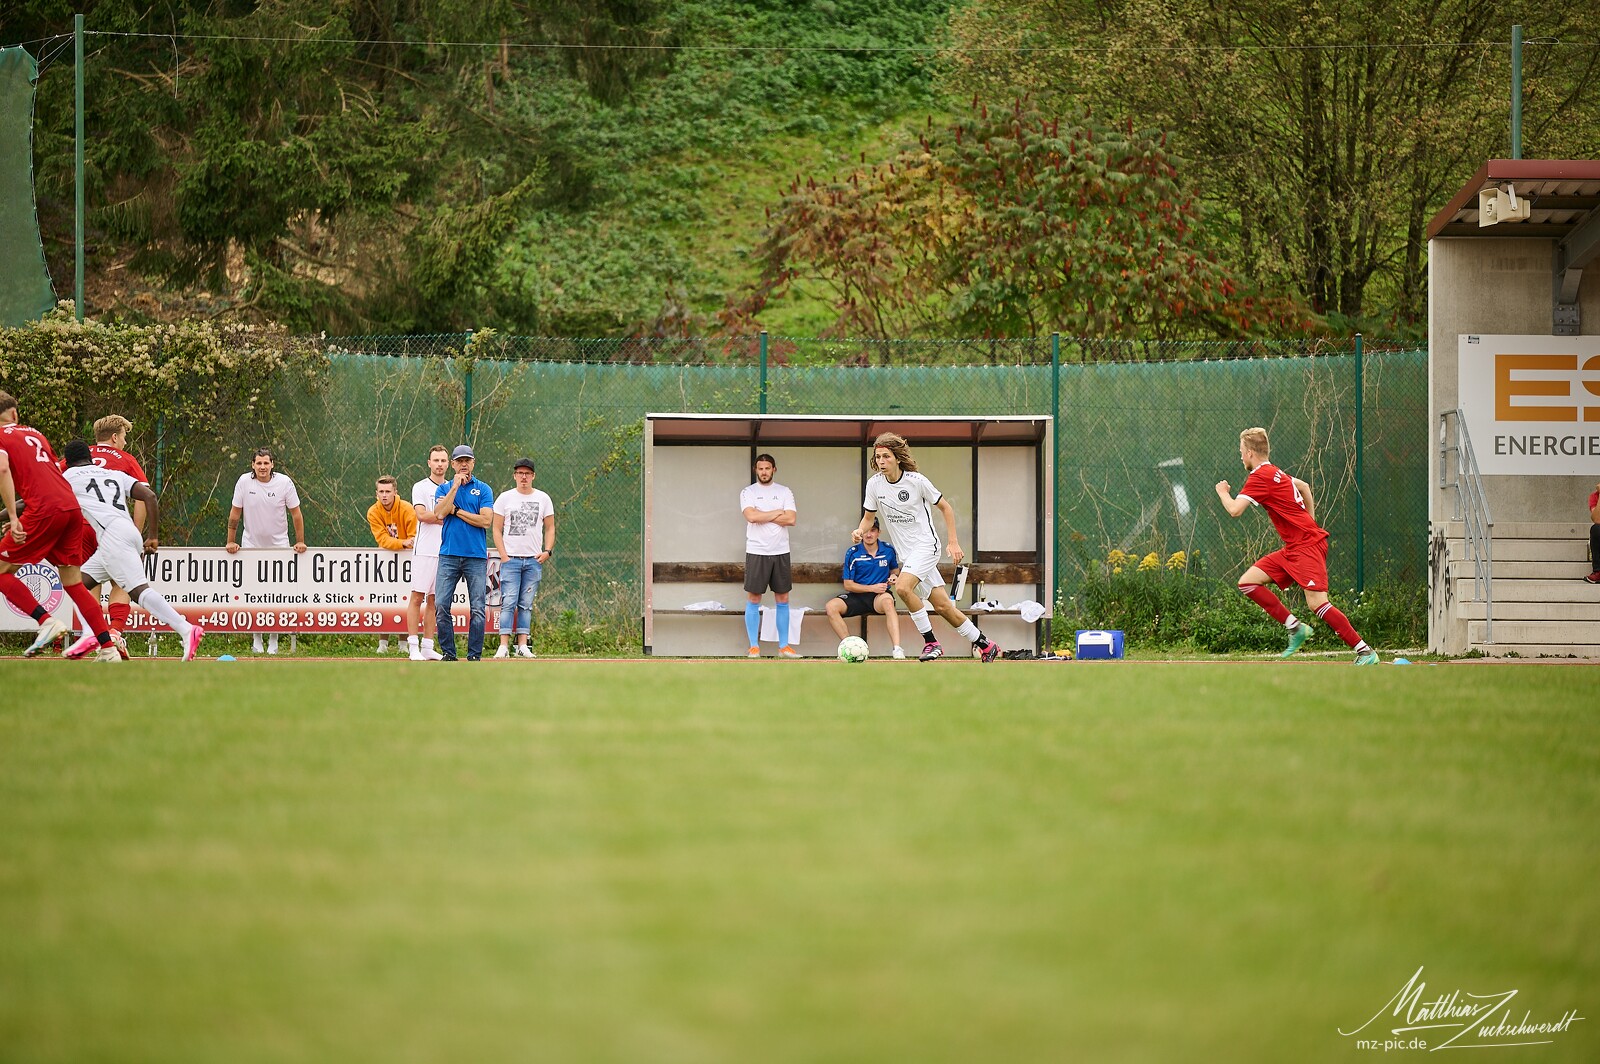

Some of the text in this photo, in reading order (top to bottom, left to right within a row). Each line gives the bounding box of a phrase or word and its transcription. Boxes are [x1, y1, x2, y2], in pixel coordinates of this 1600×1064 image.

[25, 435, 50, 462] 2
[1495, 435, 1600, 456] ENERGIE
[85, 478, 126, 511] 12
[14, 564, 60, 587] DINGER
[143, 553, 244, 588] Werbung
[257, 553, 299, 583] und
[181, 592, 208, 603] aller
[211, 593, 230, 603] Art
[244, 592, 309, 604] Textildruck
[312, 593, 321, 604] &
[325, 592, 355, 604] Stick
[369, 592, 398, 604] Print
[197, 611, 229, 627] +49
[231, 611, 253, 630] (0)
[255, 611, 275, 627] 86
[317, 611, 338, 627] 99
[340, 611, 360, 627] 32
[363, 611, 383, 627] 39
